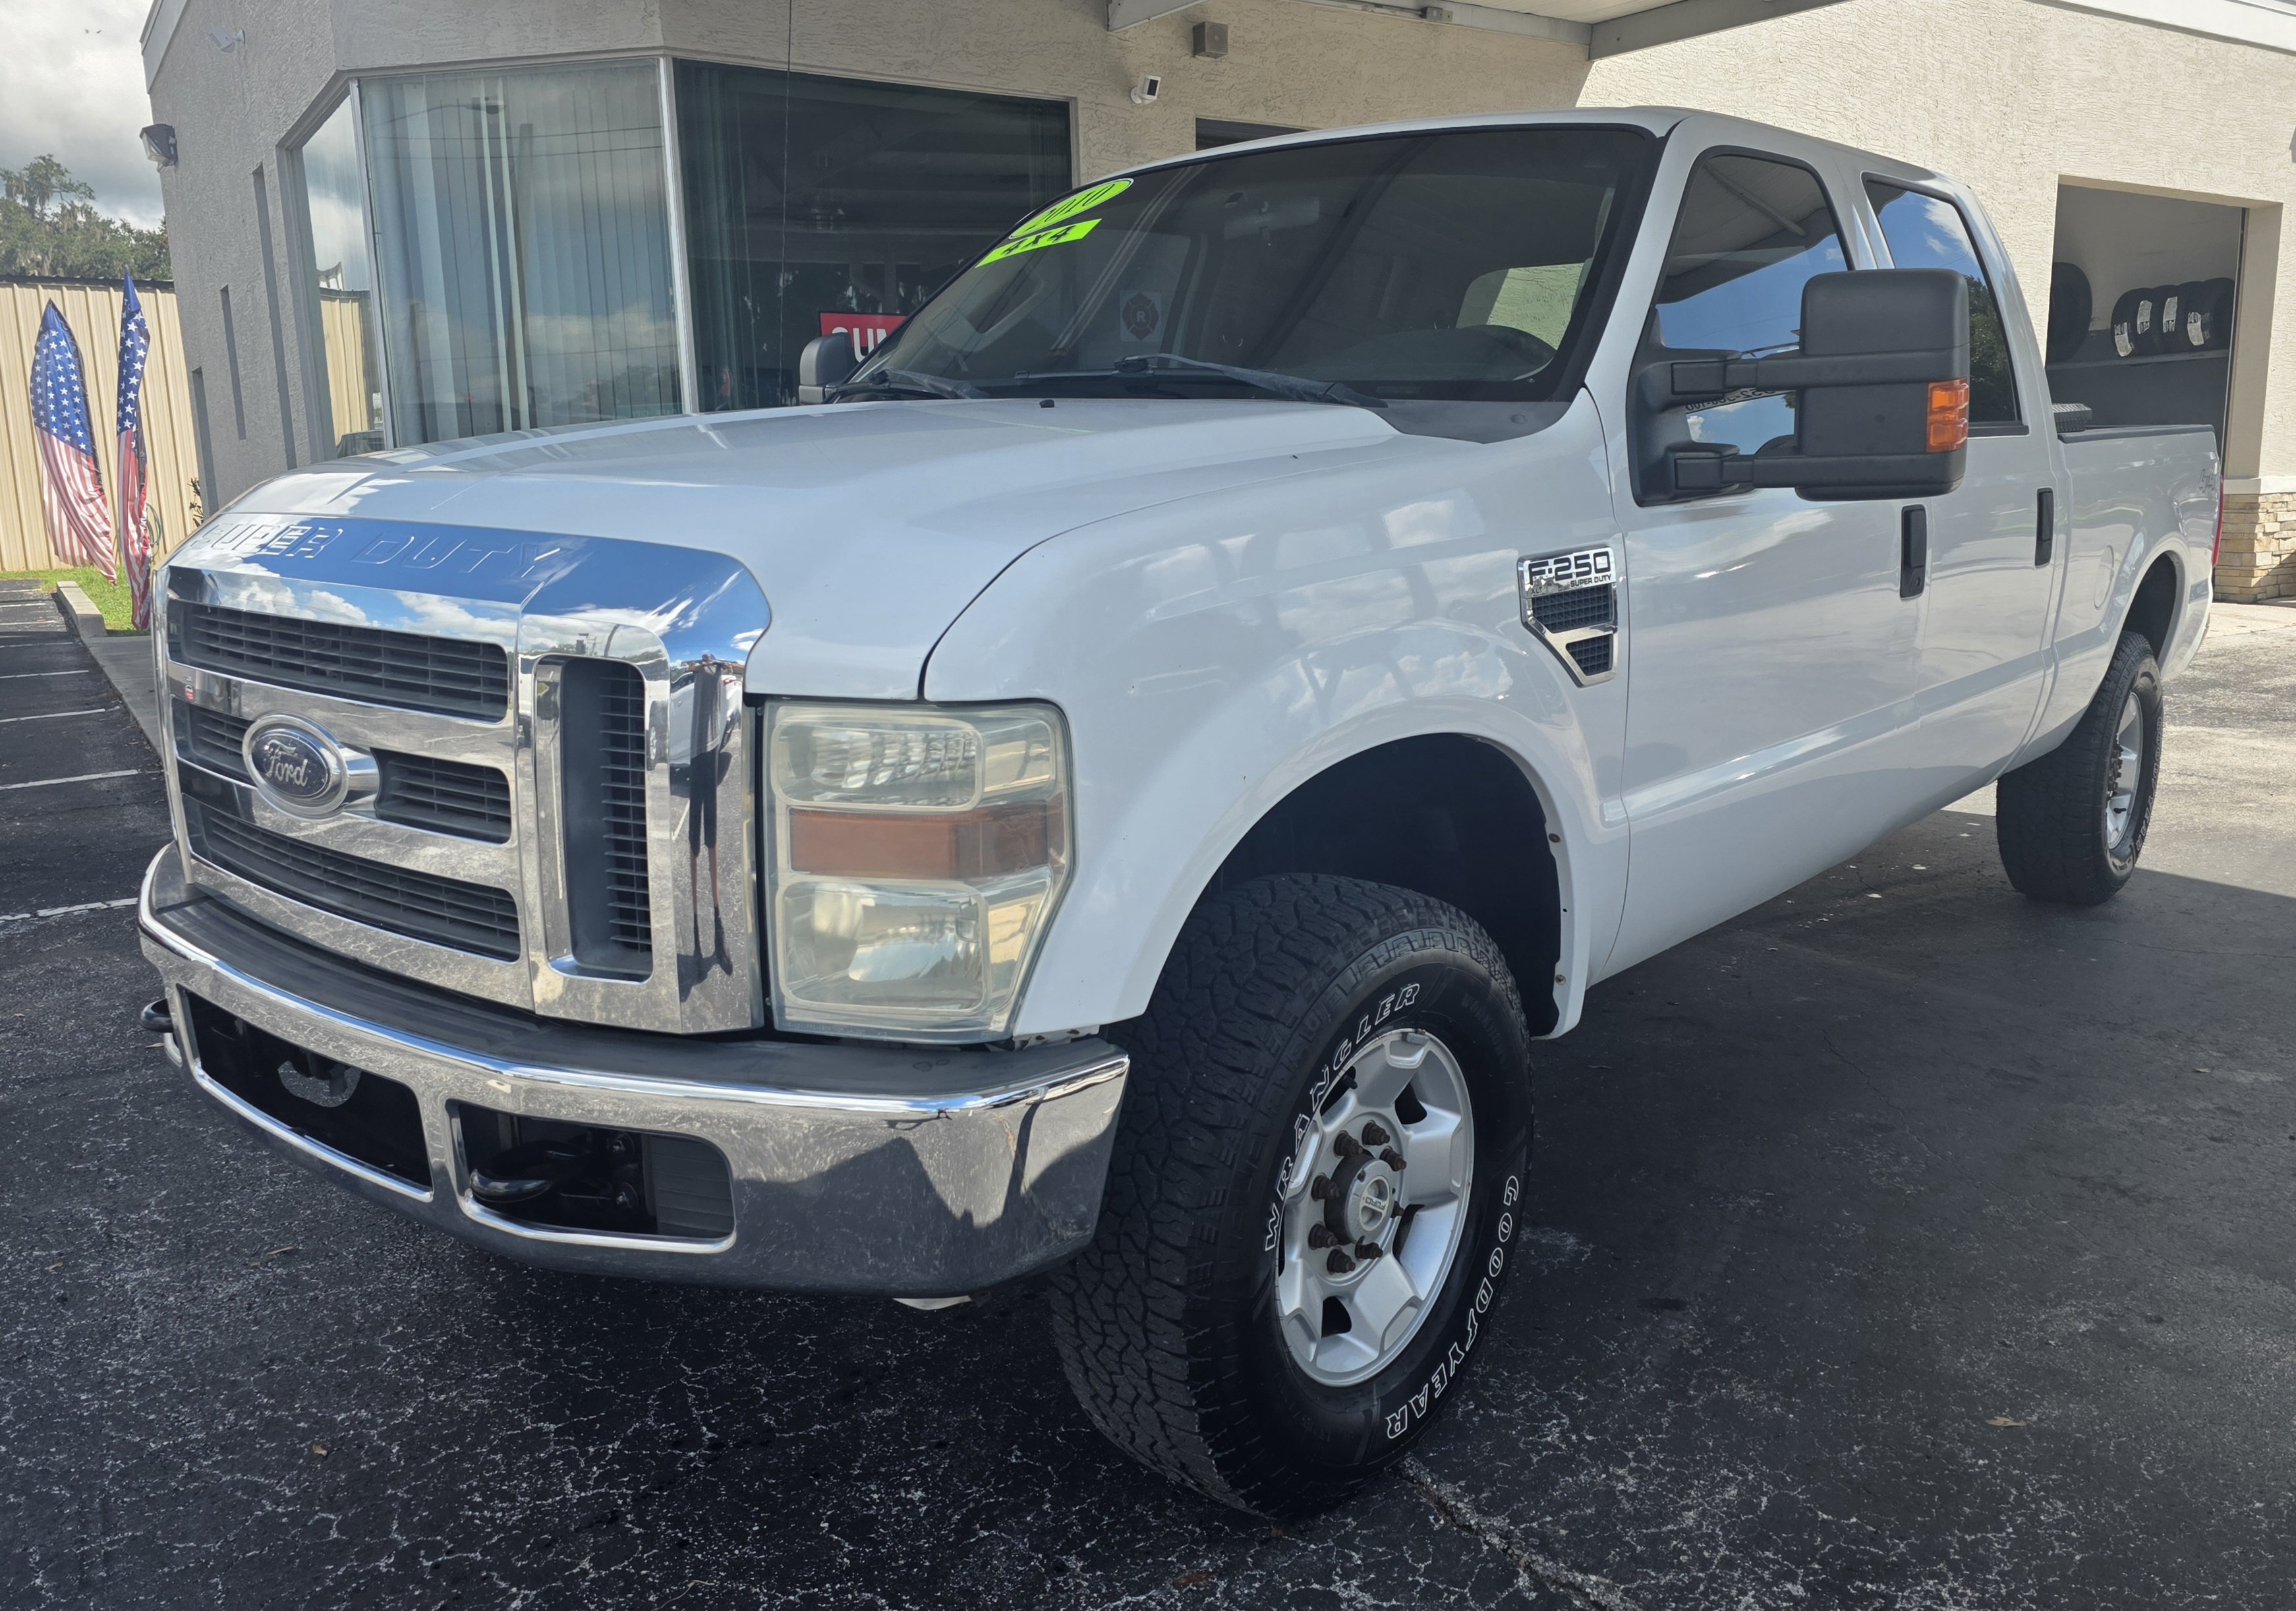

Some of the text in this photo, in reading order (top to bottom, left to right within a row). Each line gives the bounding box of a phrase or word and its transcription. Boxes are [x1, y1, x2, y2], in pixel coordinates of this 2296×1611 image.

[1023, 183, 1115, 231] 2010
[1137, 310, 1146, 322] R
[188, 524, 574, 580] SUPER DUTY
[1528, 551, 1611, 585] F-250
[1570, 574, 1611, 587] SUPER DUTY
[264, 739, 308, 787] Ford
[1265, 983, 1420, 1251] WRANGLER
[1387, 1175, 1519, 1440] GOODYEAR
